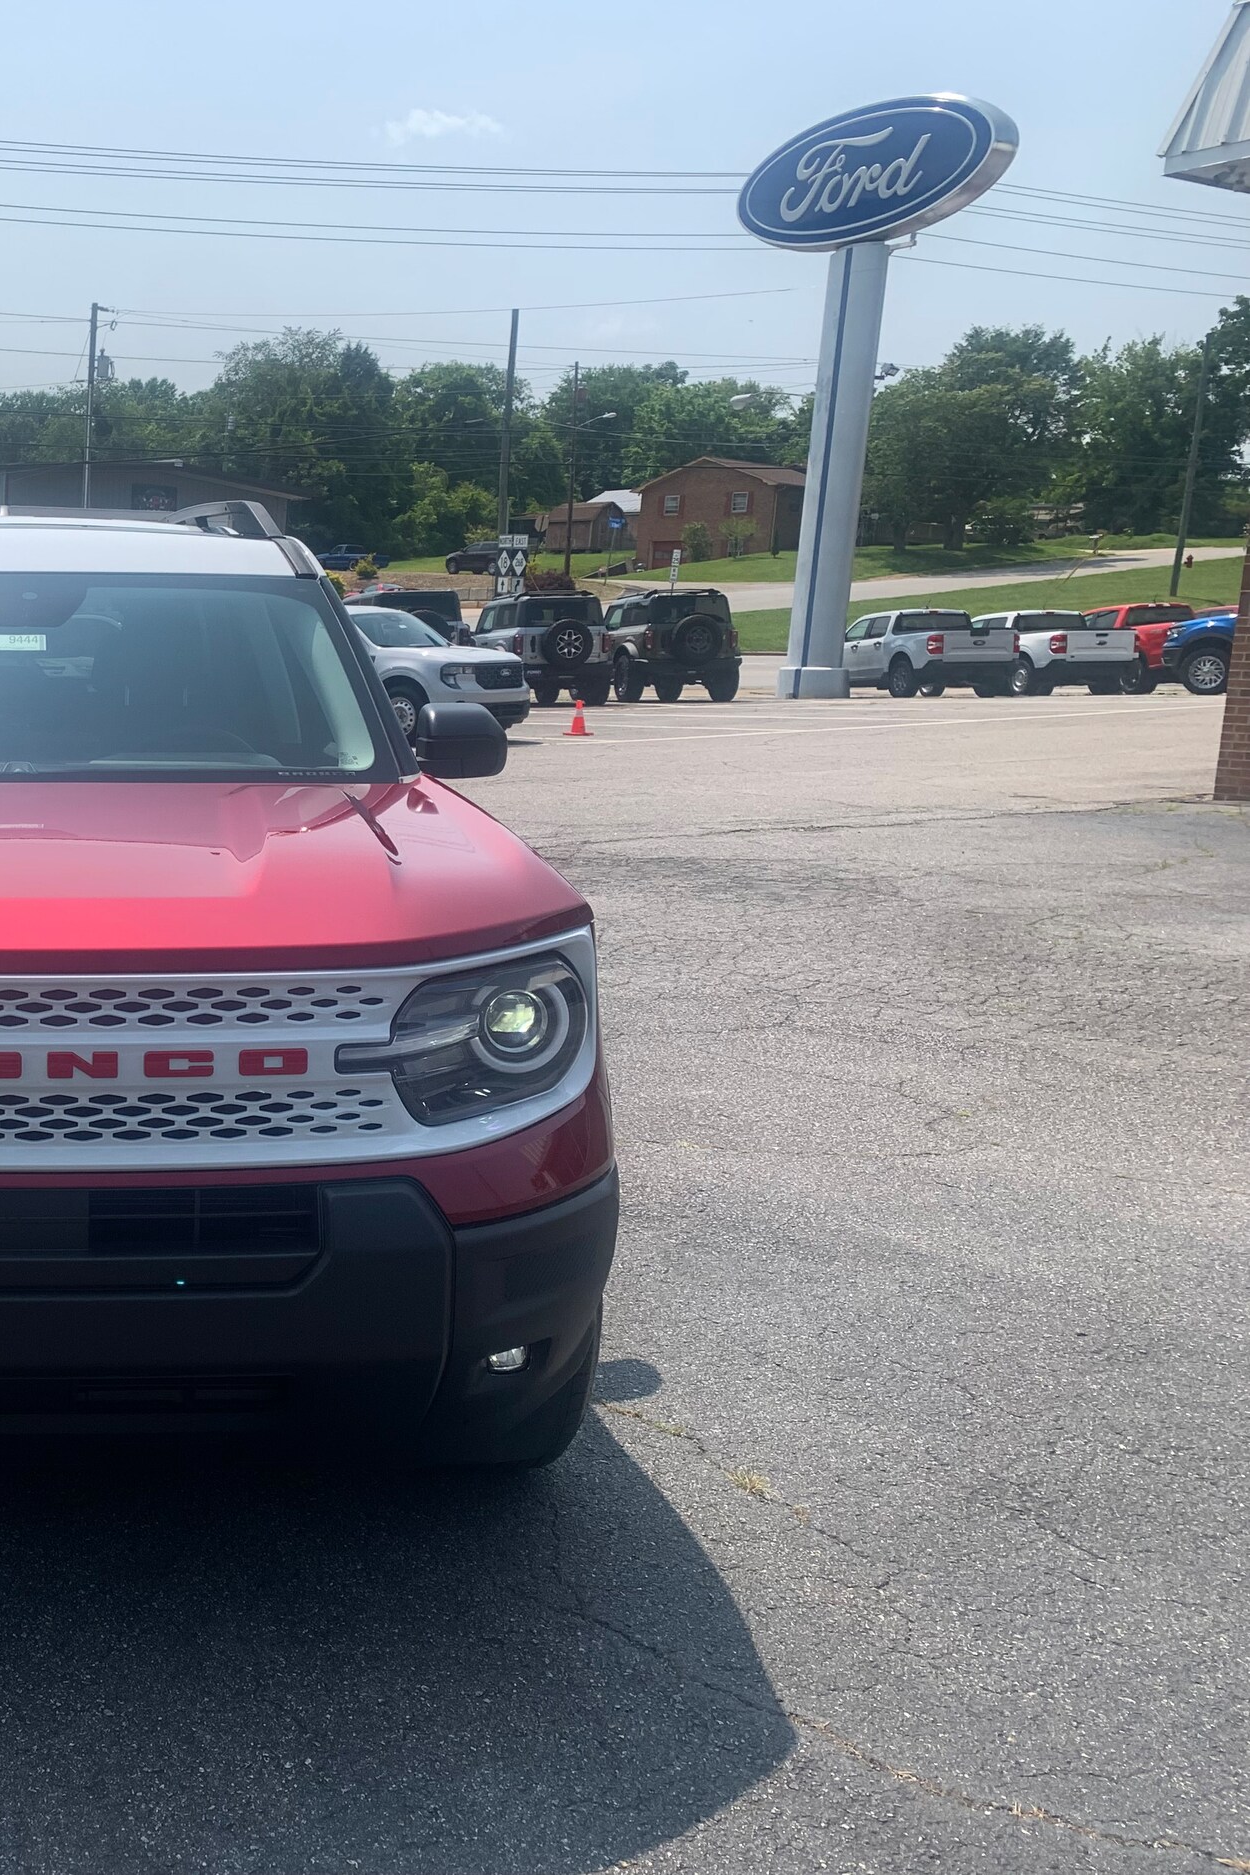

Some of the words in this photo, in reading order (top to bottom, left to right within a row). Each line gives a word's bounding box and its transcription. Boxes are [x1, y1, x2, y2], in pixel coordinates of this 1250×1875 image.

[780, 126, 932, 223] Ford
[515, 537, 527, 546] EAST
[500, 556, 508, 569] 18
[8, 635, 38, 644] 9444
